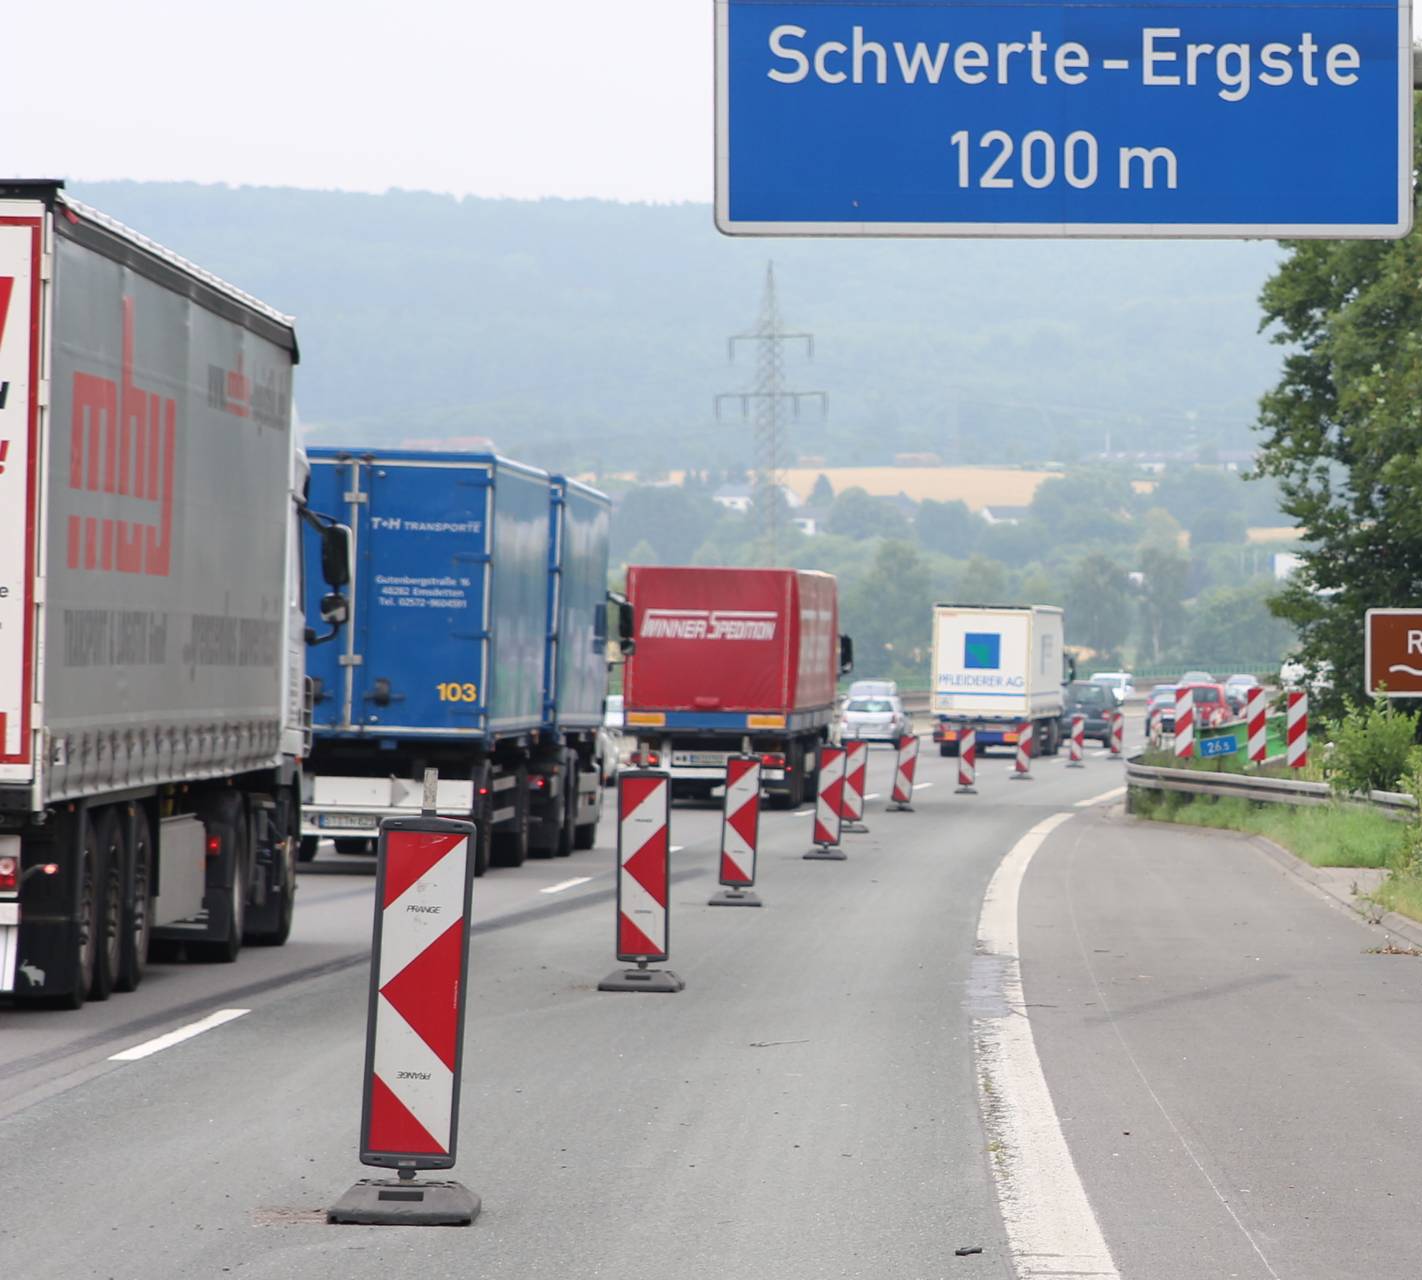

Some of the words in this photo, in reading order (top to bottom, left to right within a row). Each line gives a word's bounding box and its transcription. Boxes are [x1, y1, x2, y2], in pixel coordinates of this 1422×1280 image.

[950, 130, 1098, 189] 1200
[1119, 146, 1178, 189] m
[1005, 675, 1025, 688] AG
[436, 683, 477, 702] 103
[406, 905, 442, 914] PRANGE
